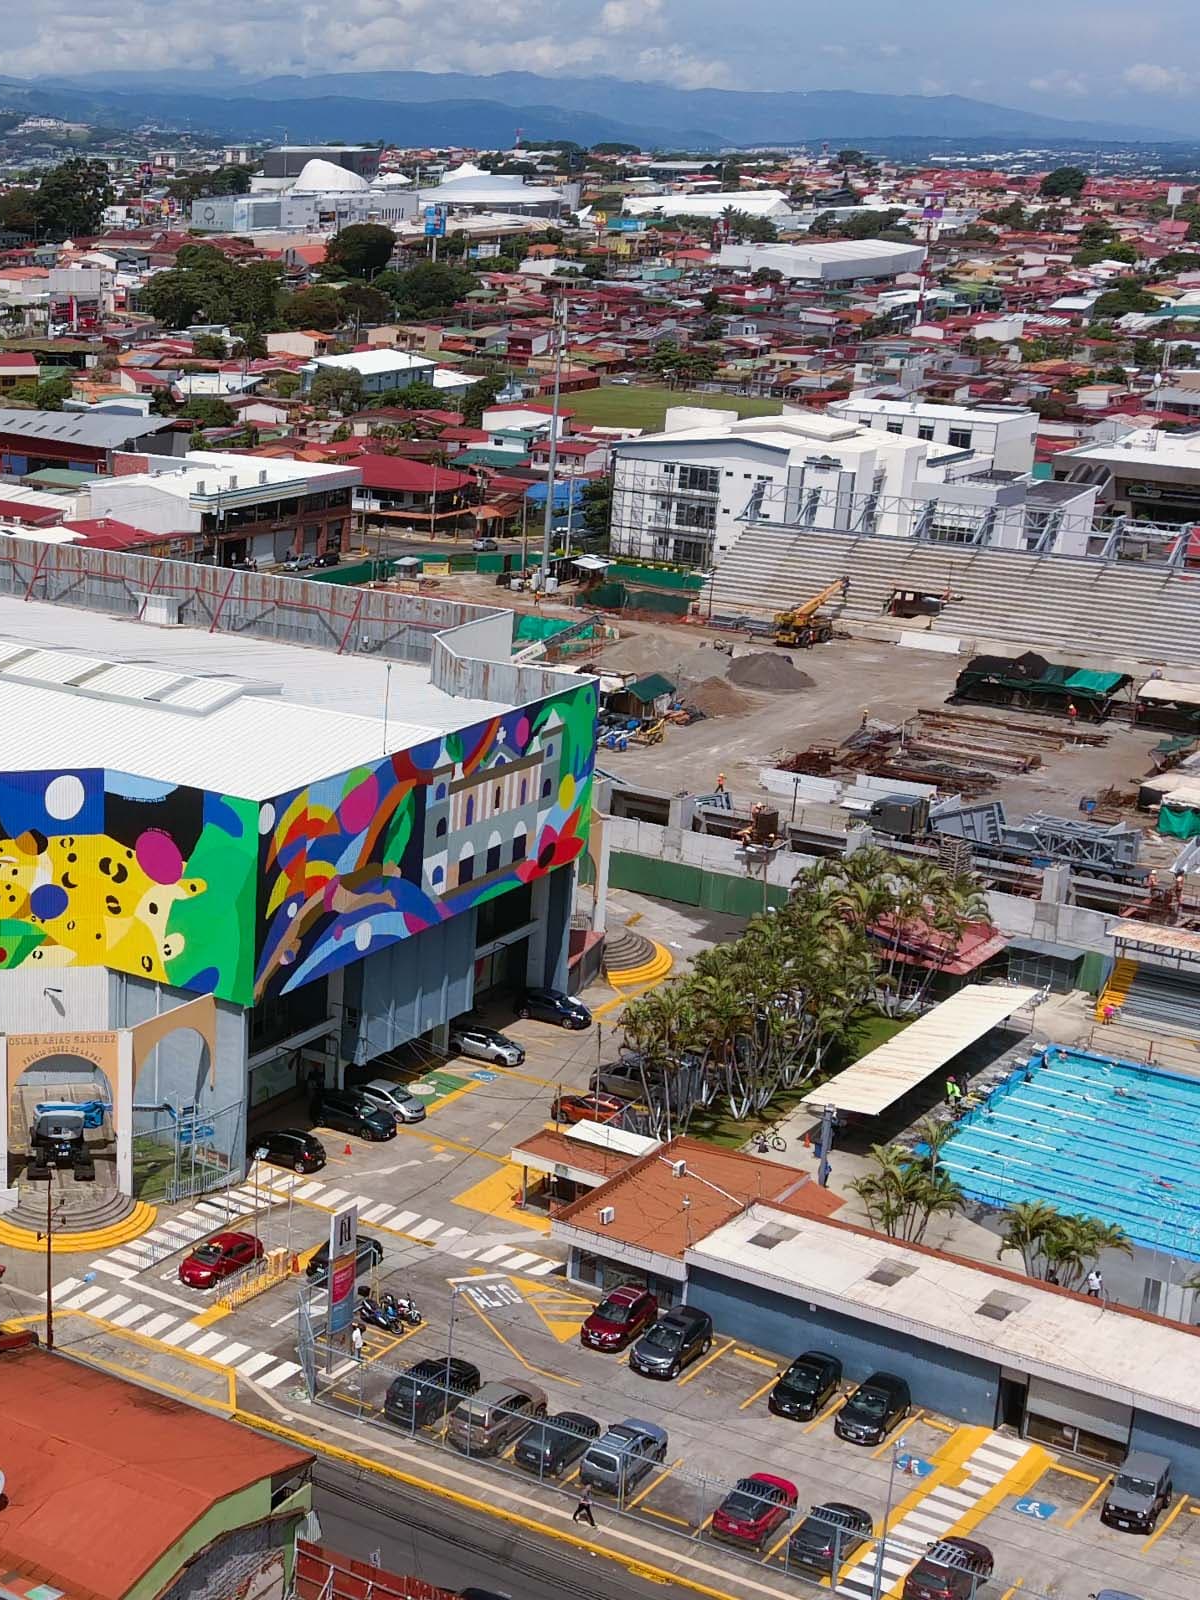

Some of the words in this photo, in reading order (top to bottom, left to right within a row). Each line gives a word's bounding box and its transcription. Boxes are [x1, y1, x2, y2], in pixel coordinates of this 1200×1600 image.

[8, 1037, 40, 1046] OSCAR
[43, 1035, 71, 1045] ARIAS
[466, 1284, 523, 1308] ALTO
